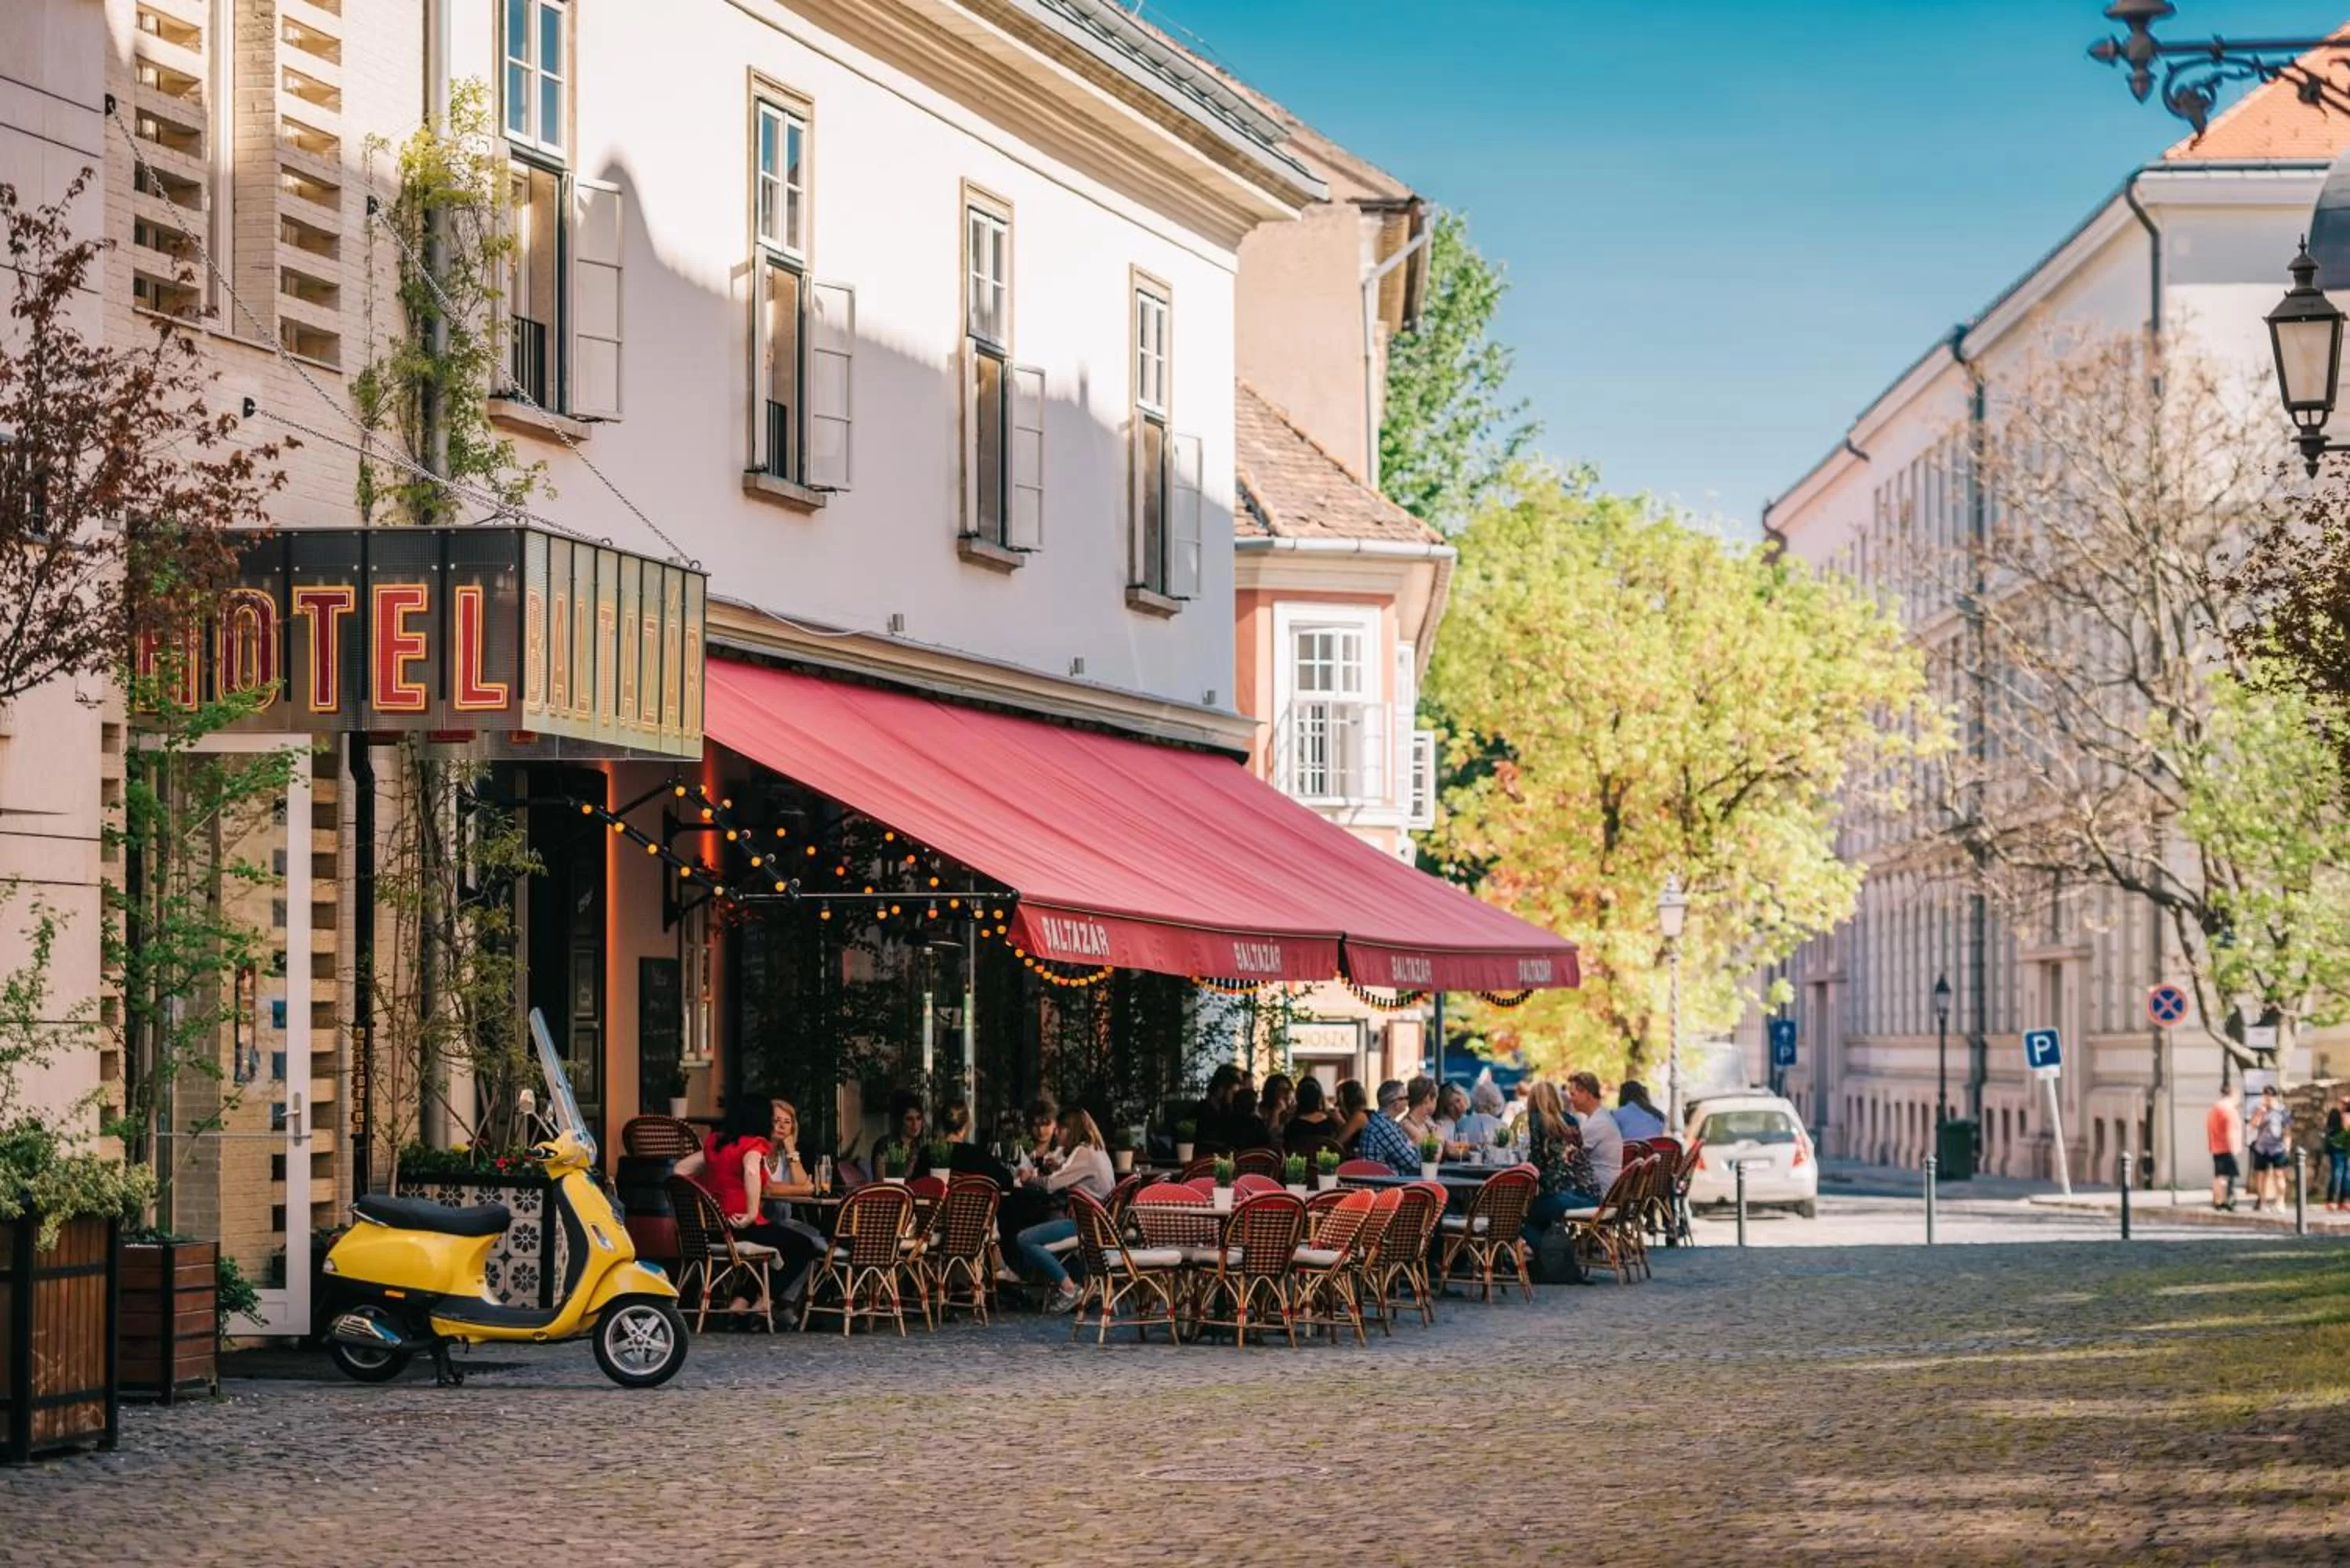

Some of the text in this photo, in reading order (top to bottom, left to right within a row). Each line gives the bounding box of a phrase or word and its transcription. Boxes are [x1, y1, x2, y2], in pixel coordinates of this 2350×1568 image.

[135, 584, 508, 712] HOTEL
[525, 581, 701, 740] BALTAZÁR
[1041, 916, 1110, 956] BALTAZÁR
[1233, 937, 1282, 972] BALTAZÁR
[1780, 1046, 1792, 1064] P
[2033, 1035, 2052, 1064] P
